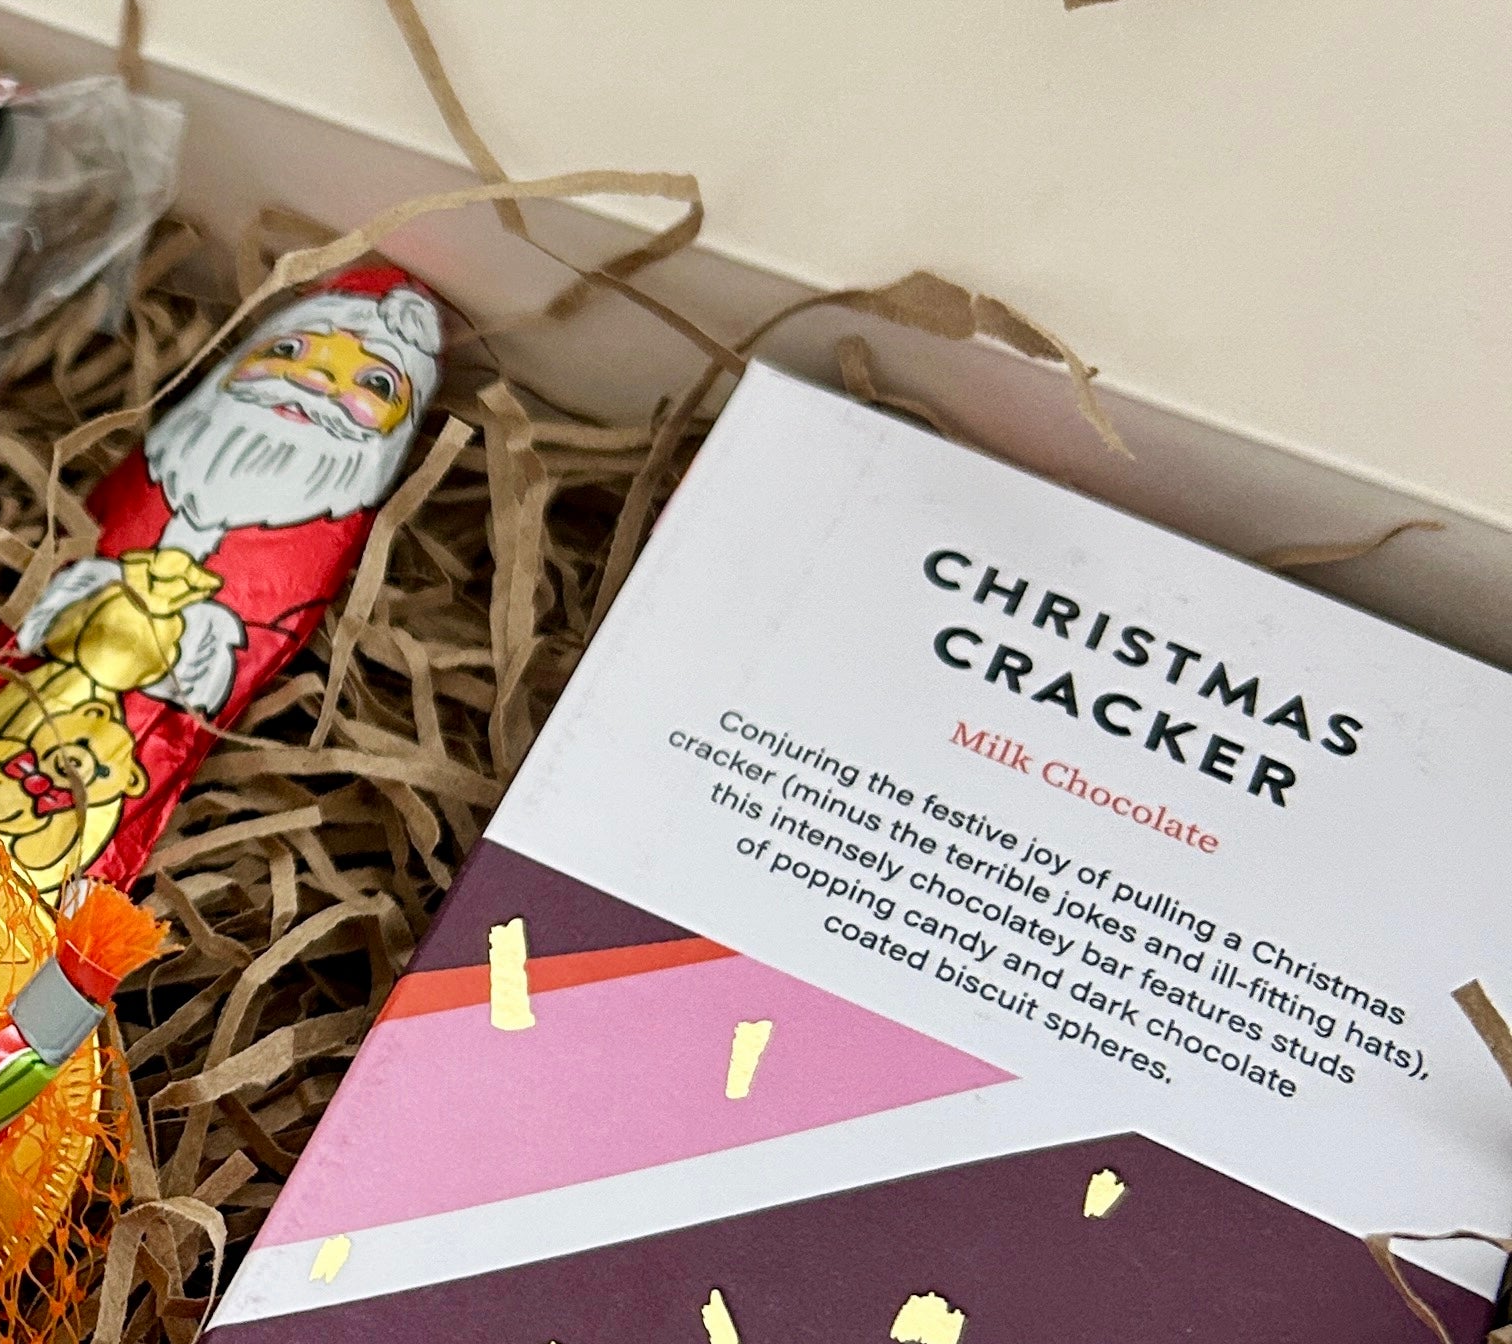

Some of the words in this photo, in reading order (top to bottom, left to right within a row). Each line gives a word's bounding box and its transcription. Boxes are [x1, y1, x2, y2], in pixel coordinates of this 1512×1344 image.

[922, 549, 1364, 757] CHRISTMAS
[932, 626, 1297, 808] CRACKER
[719, 709, 860, 788] Conjuring
[867, 771, 915, 807] the
[923, 794, 1019, 850] festive
[1021, 836, 1071, 876] joy
[1077, 865, 1110, 890] of
[1111, 880, 1217, 943] pulling
[1223, 929, 1243, 952] a
[1252, 940, 1406, 1026] Christmas
[948, 720, 1036, 775] Milk
[1041, 759, 1221, 854] Chocolate
[668, 729, 778, 786] cracker
[781, 773, 882, 833] (minus
[890, 819, 937, 855] the
[945, 842, 1052, 904] terrible
[1053, 890, 1137, 944] jokes
[1144, 932, 1206, 974] and
[1210, 957, 1338, 1039] ill-fitting
[1345, 1019, 1430, 1082] hats),
[710, 780, 762, 820] this
[770, 806, 905, 882] intensely
[908, 868, 1075, 957] chocolatey
[1081, 940, 1135, 982] bar
[1139, 967, 1264, 1043] features
[1270, 1031, 1357, 1085] studs
[736, 836, 771, 861] of
[770, 851, 896, 921] popping
[903, 908, 997, 962] candy
[1003, 951, 1065, 990] and
[1069, 979, 1142, 1027] dark
[1145, 1013, 1298, 1099] chocolate
[823, 915, 930, 971] coated
[934, 956, 1040, 1021] biscuit
[1043, 1010, 1173, 1085] spheres.
